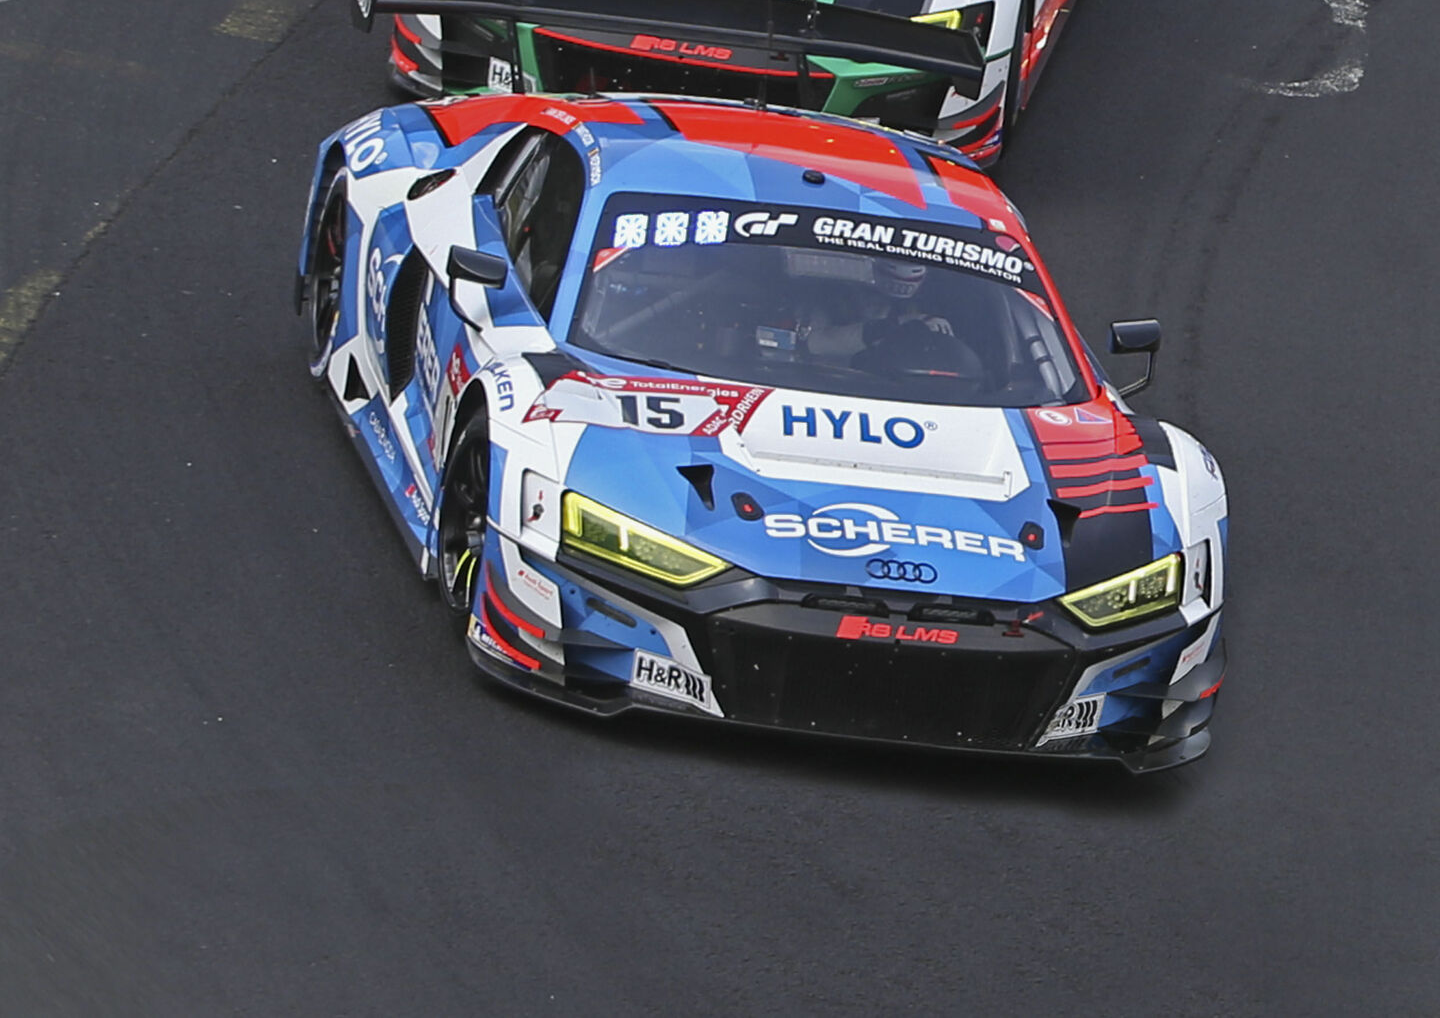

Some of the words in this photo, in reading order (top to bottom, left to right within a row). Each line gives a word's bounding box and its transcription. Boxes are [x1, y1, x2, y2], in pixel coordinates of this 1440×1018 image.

[679, 40, 734, 61] LMS
[812, 216, 896, 245] GRAN
[815, 234, 845, 247] THE
[845, 238, 885, 254] REAL
[886, 244, 944, 264] DRIVING
[945, 253, 1022, 284] SIMULATOR
[628, 380, 741, 399] TotalEnergies
[615, 394, 685, 430] 15
[702, 414, 728, 436] ADAC
[763, 513, 1027, 563] SCHERER
[894, 626, 959, 645] LMS
